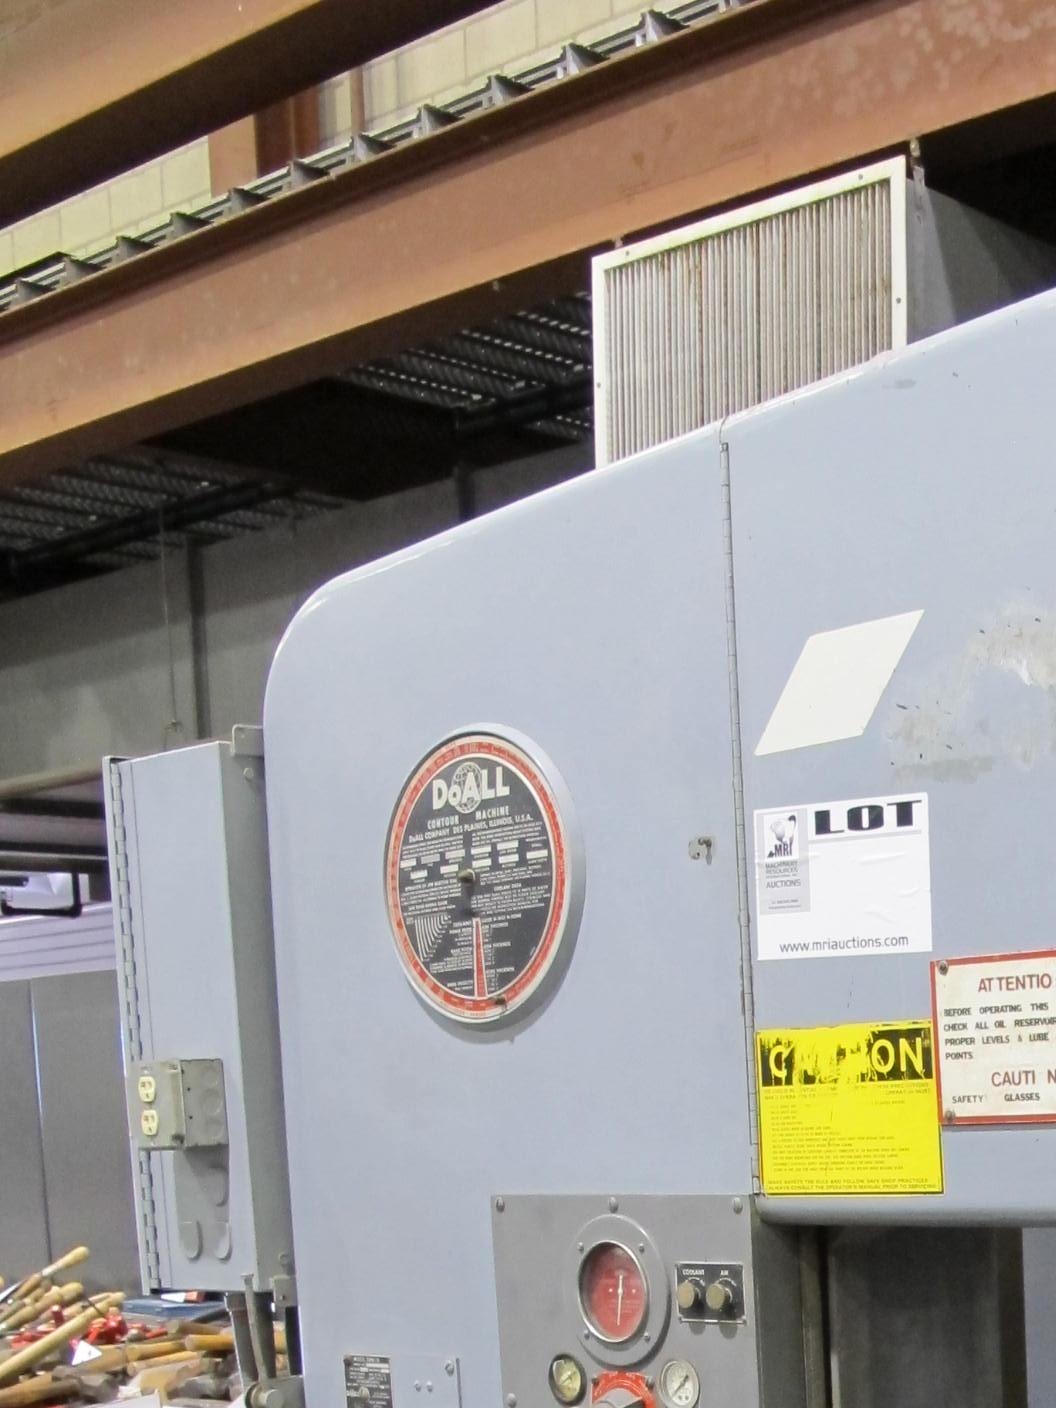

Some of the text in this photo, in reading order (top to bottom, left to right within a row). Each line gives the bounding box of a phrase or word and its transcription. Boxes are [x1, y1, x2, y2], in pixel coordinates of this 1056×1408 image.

[432, 766, 510, 810] DoALL
[427, 806, 509, 830] CONTOUR MACHINE
[815, 800, 922, 836] LOT
[425, 828, 450, 840] COMPANY
[453, 825, 463, 834] DES
[774, 842, 793, 857] MRI
[766, 879, 801, 888] AUCTIONS
[779, 935, 909, 953] www.mriauctions.com
[944, 1007, 972, 1017] BEFORE
[979, 1004, 1022, 1015] OPERATING
[1030, 1002, 1049, 1011] THIS
[944, 1022, 968, 1032] CHECK
[975, 1021, 989, 1030] ALL
[994, 1020, 1006, 1028] OIL
[945, 1037, 976, 1046] PROPER
[982, 1034, 1010, 1045] LEVELS
[1029, 1032, 1049, 1042] LUBE
[945, 1050, 973, 1060] POINTS
[952, 1094, 984, 1104] SAFETY
[1004, 1092, 1040, 1102] GLASSES
[682, 1268, 705, 1276] COOLANT
